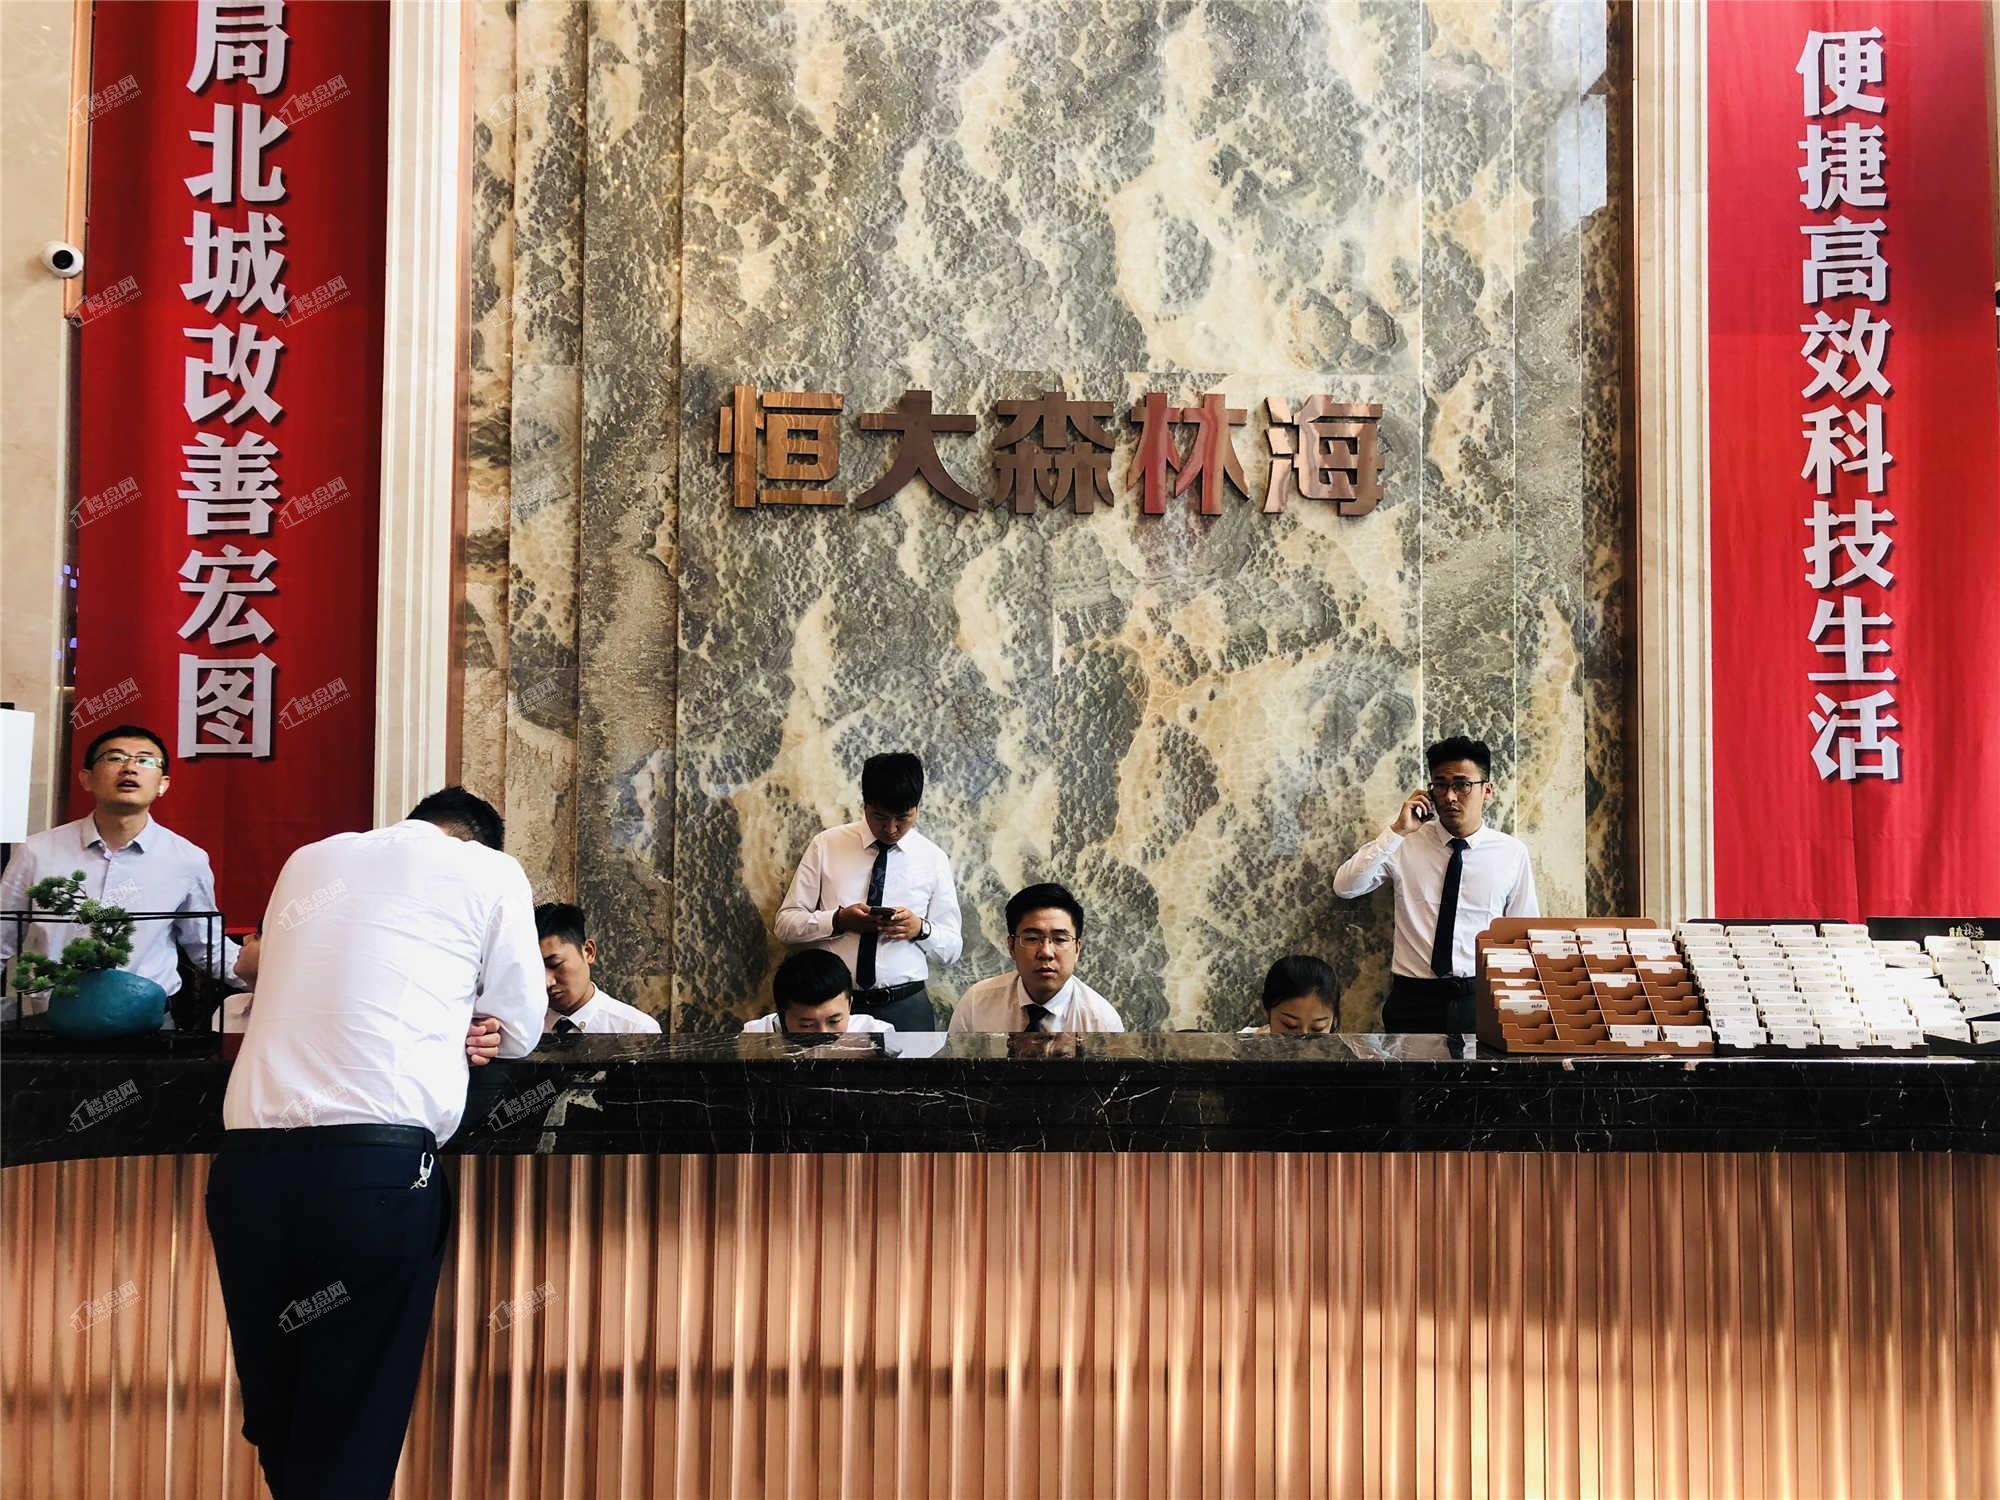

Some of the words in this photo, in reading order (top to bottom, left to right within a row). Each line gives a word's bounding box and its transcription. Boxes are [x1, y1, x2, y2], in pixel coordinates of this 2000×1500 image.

[177, 0, 290, 759] 局北城改善宏图
[717, 385, 1385, 516] 恒大森林海
[1796, 26, 1901, 781] 便捷高效科技生活
